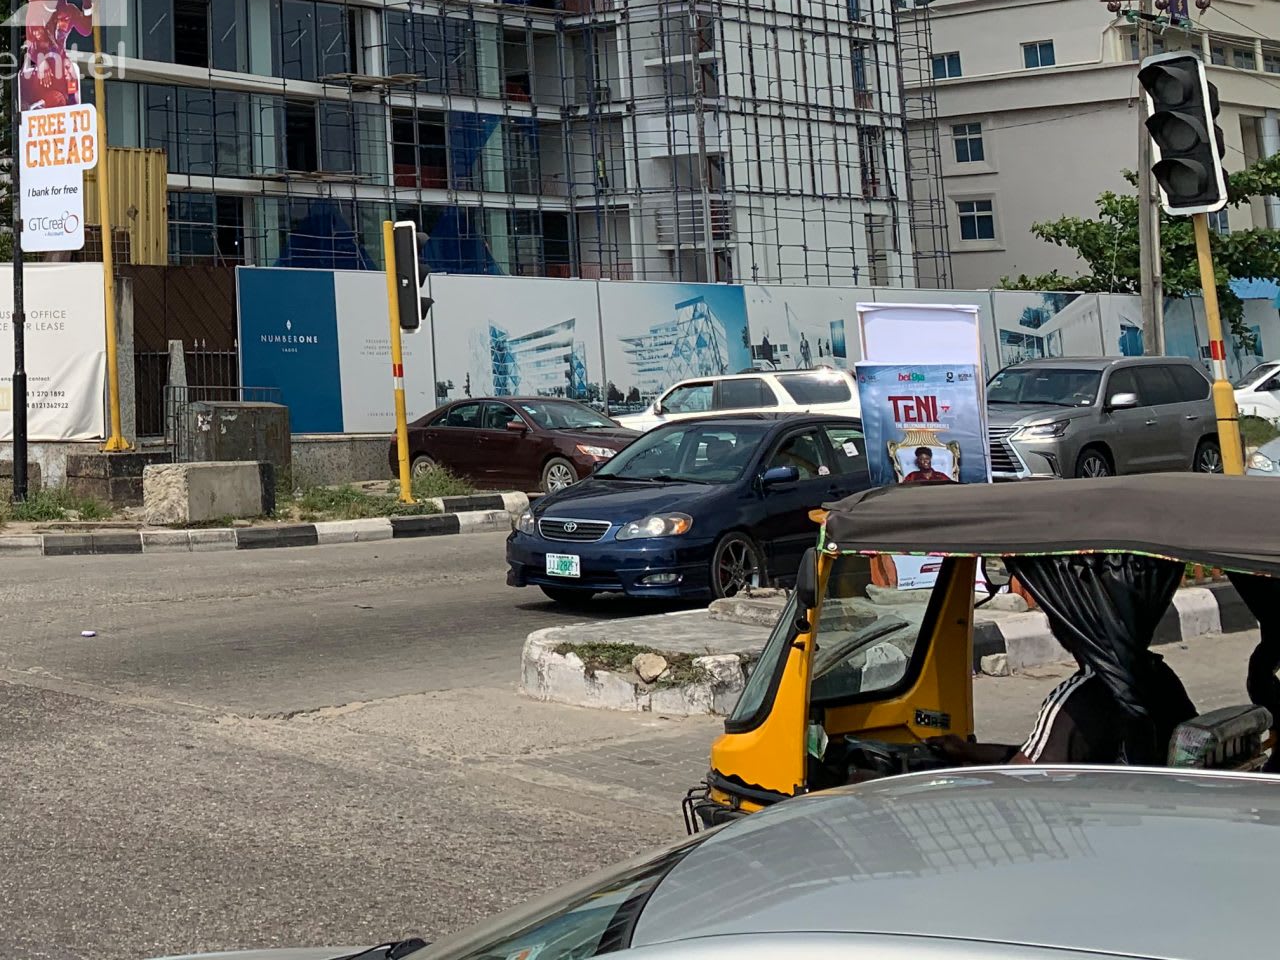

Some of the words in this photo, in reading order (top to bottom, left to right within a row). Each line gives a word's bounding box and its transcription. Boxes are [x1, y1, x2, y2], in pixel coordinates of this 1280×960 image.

[27, 112, 66, 138] FREE
[70, 109, 91, 133] TO
[25, 134, 94, 169] CREA8
[31, 186, 49, 197] bank
[51, 185, 62, 196] for
[63, 184, 78, 195] free
[30, 310, 67, 319] OFFICE
[35, 322, 65, 331] LEASE
[261, 335, 318, 344] NUMBERONE
[888, 395, 940, 423] TENI
